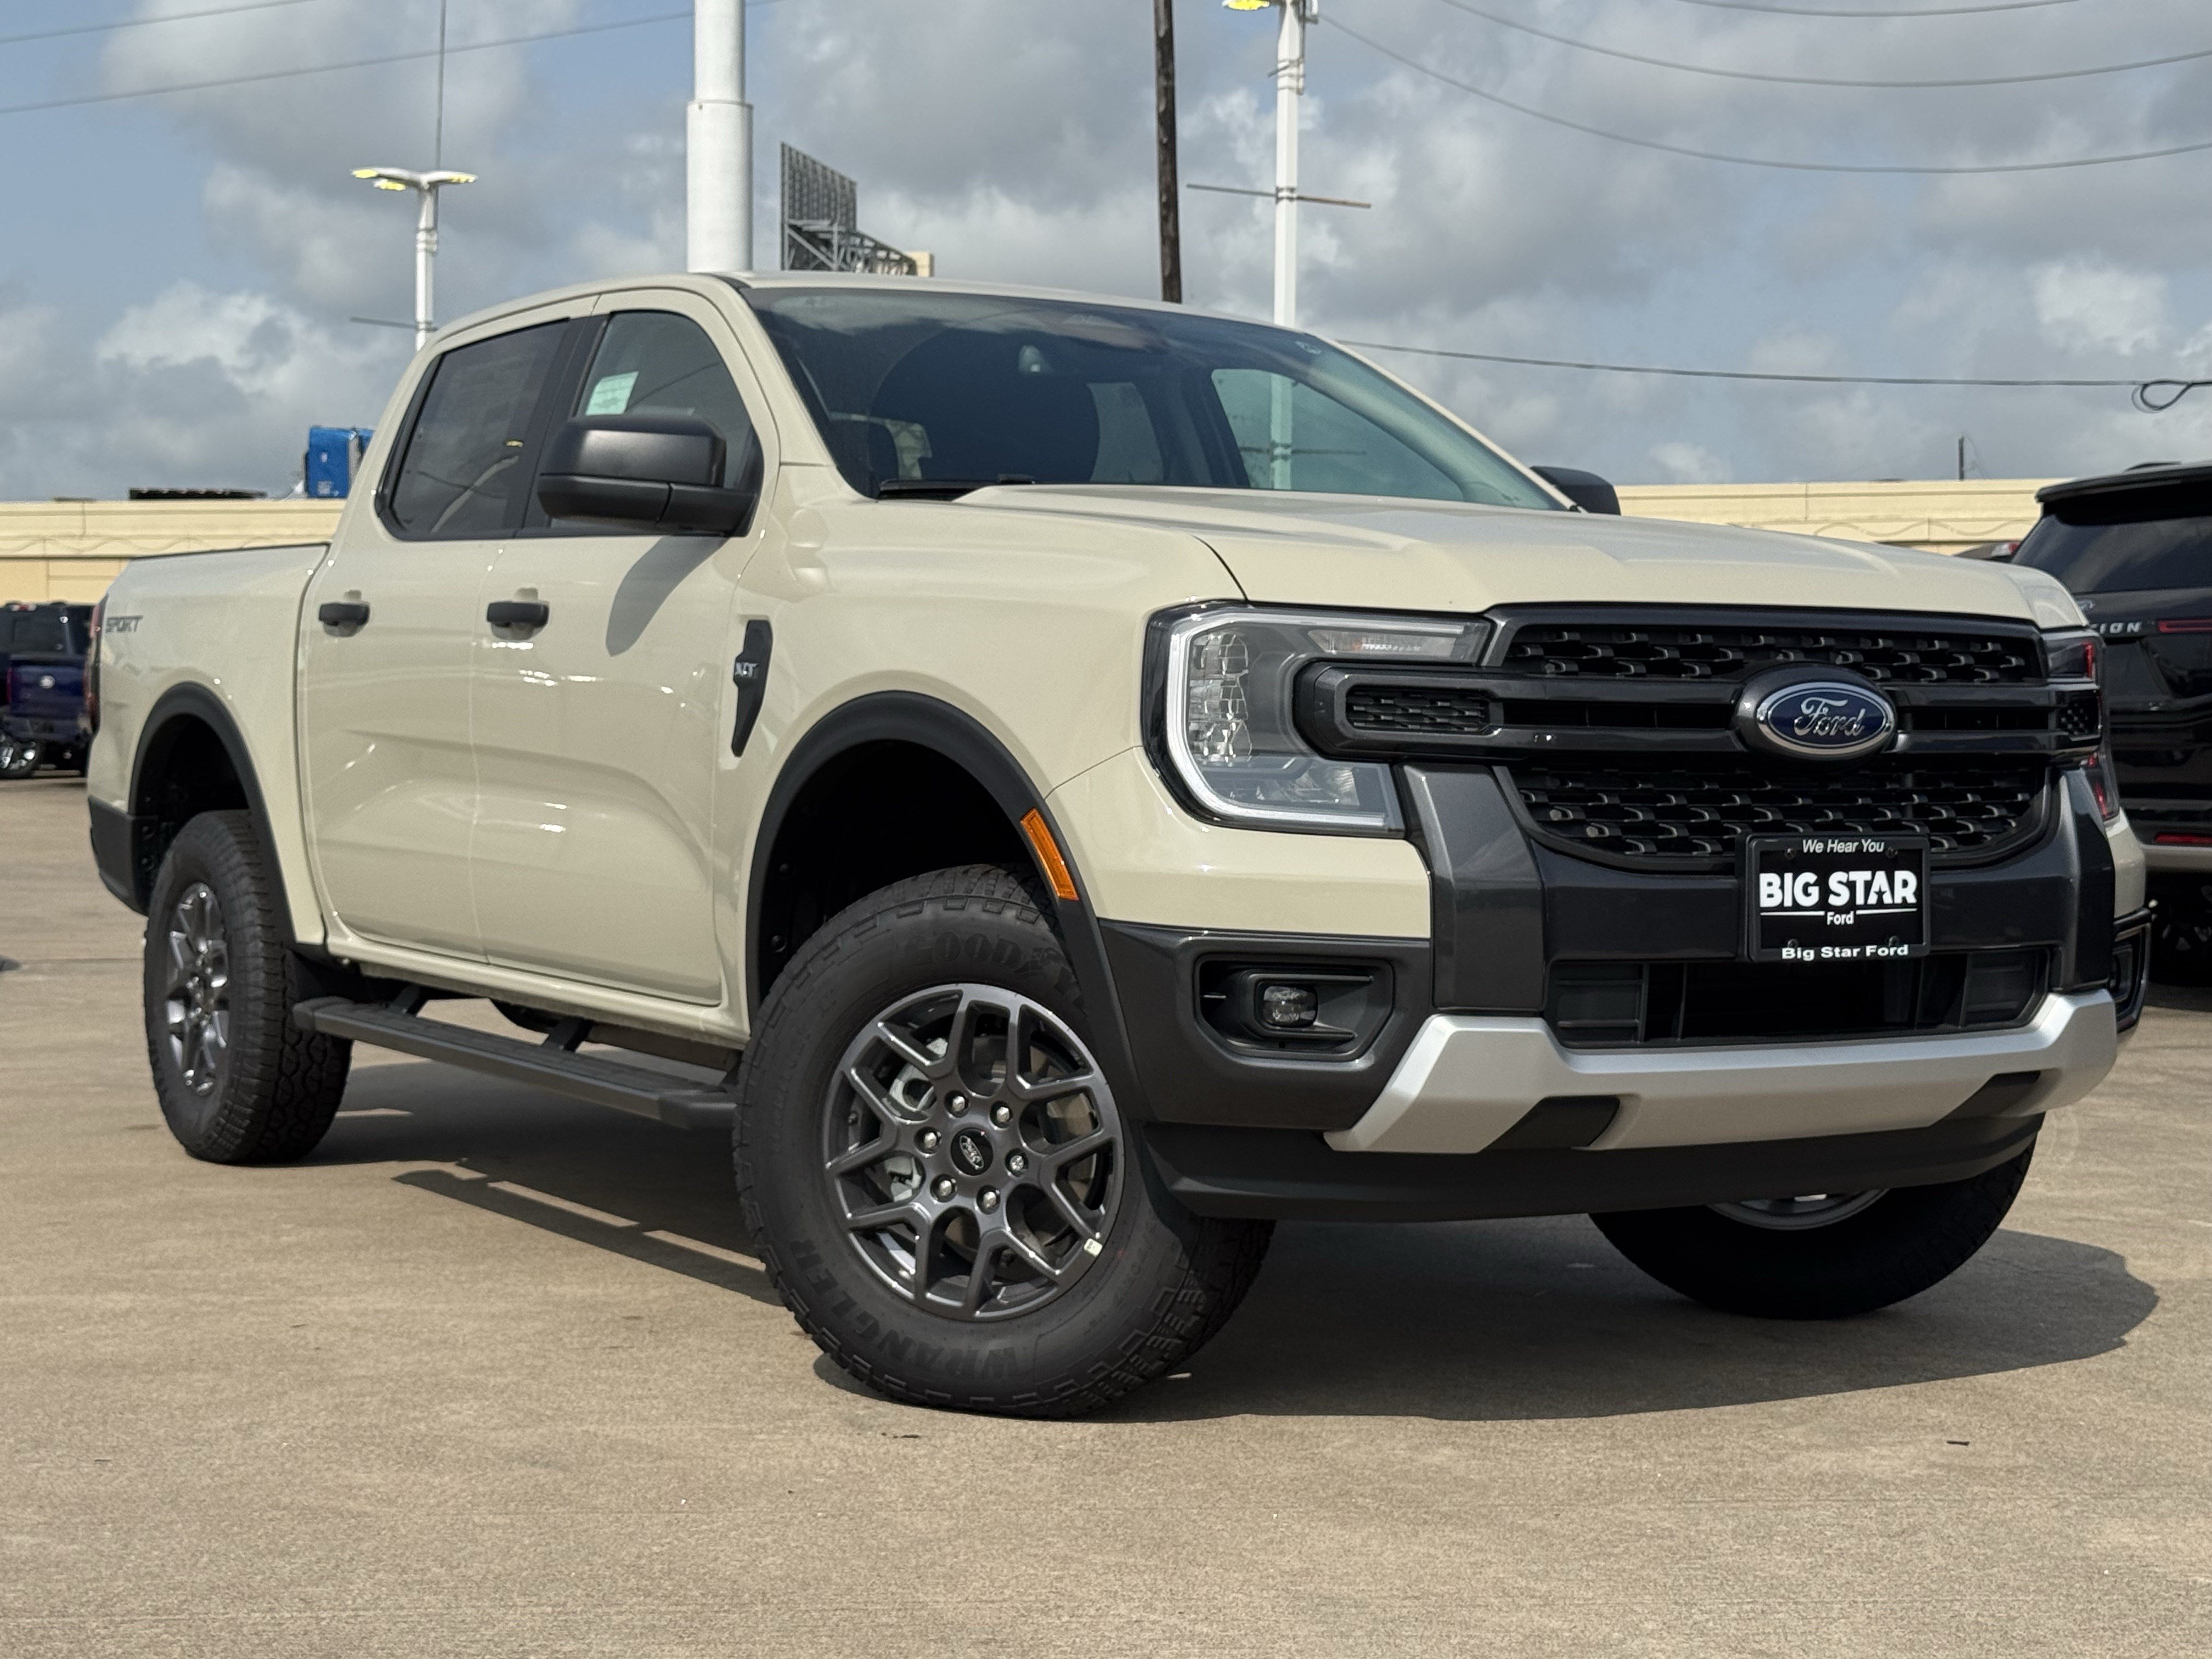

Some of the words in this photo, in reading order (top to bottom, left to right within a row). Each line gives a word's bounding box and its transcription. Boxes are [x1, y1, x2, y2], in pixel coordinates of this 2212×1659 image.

[105, 615, 143, 633] SPORT
[1794, 697, 1865, 736] Ford
[1803, 839, 1824, 853] We
[1827, 839, 1859, 853] Hear
[1861, 839, 1884, 852] You
[1759, 872, 1819, 907] BIG
[1829, 871, 1917, 906] STAR
[1827, 911, 1854, 925] Ford
[1782, 947, 1814, 961] Big
[1821, 946, 1860, 958] Star
[1866, 944, 1908, 956] Ford
[789, 1238, 1019, 1379] WRANGLER
